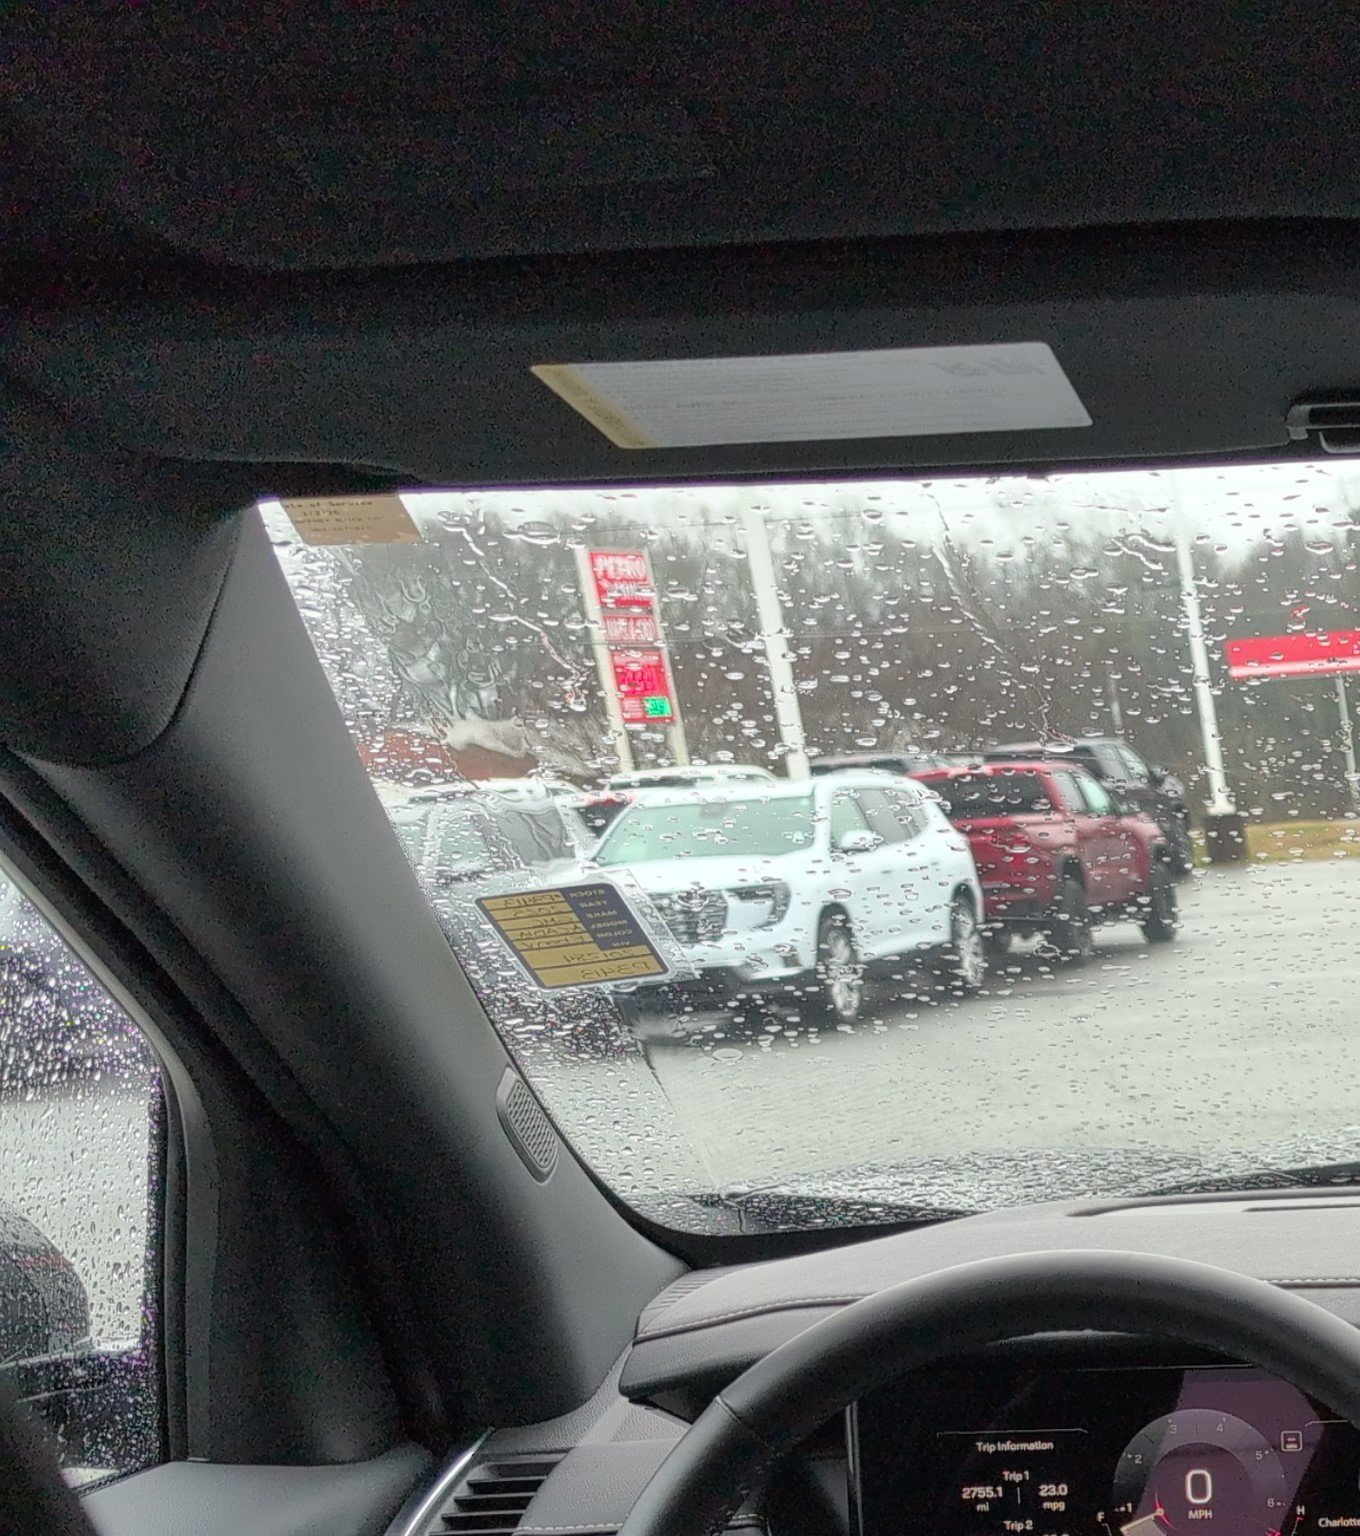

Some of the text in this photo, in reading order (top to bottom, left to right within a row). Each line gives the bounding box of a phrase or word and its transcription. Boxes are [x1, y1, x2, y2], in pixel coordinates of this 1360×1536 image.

[1170, 1424, 1178, 1435] 3
[1216, 1422, 1224, 1433] 4
[975, 1440, 1055, 1453] Trip Information
[1002, 1471, 1023, 1483] Trip
[961, 1485, 1003, 1500] 2755.1
[1038, 1483, 1069, 1497] 23.0
[1186, 1470, 1212, 1504] 0
[975, 1501, 990, 1512] mi
[1042, 1501, 1066, 1512] mpg
[1296, 1505, 1305, 1515] H
[1187, 1508, 1213, 1520] MPH
[1003, 1519, 1034, 1532] Trip 2
